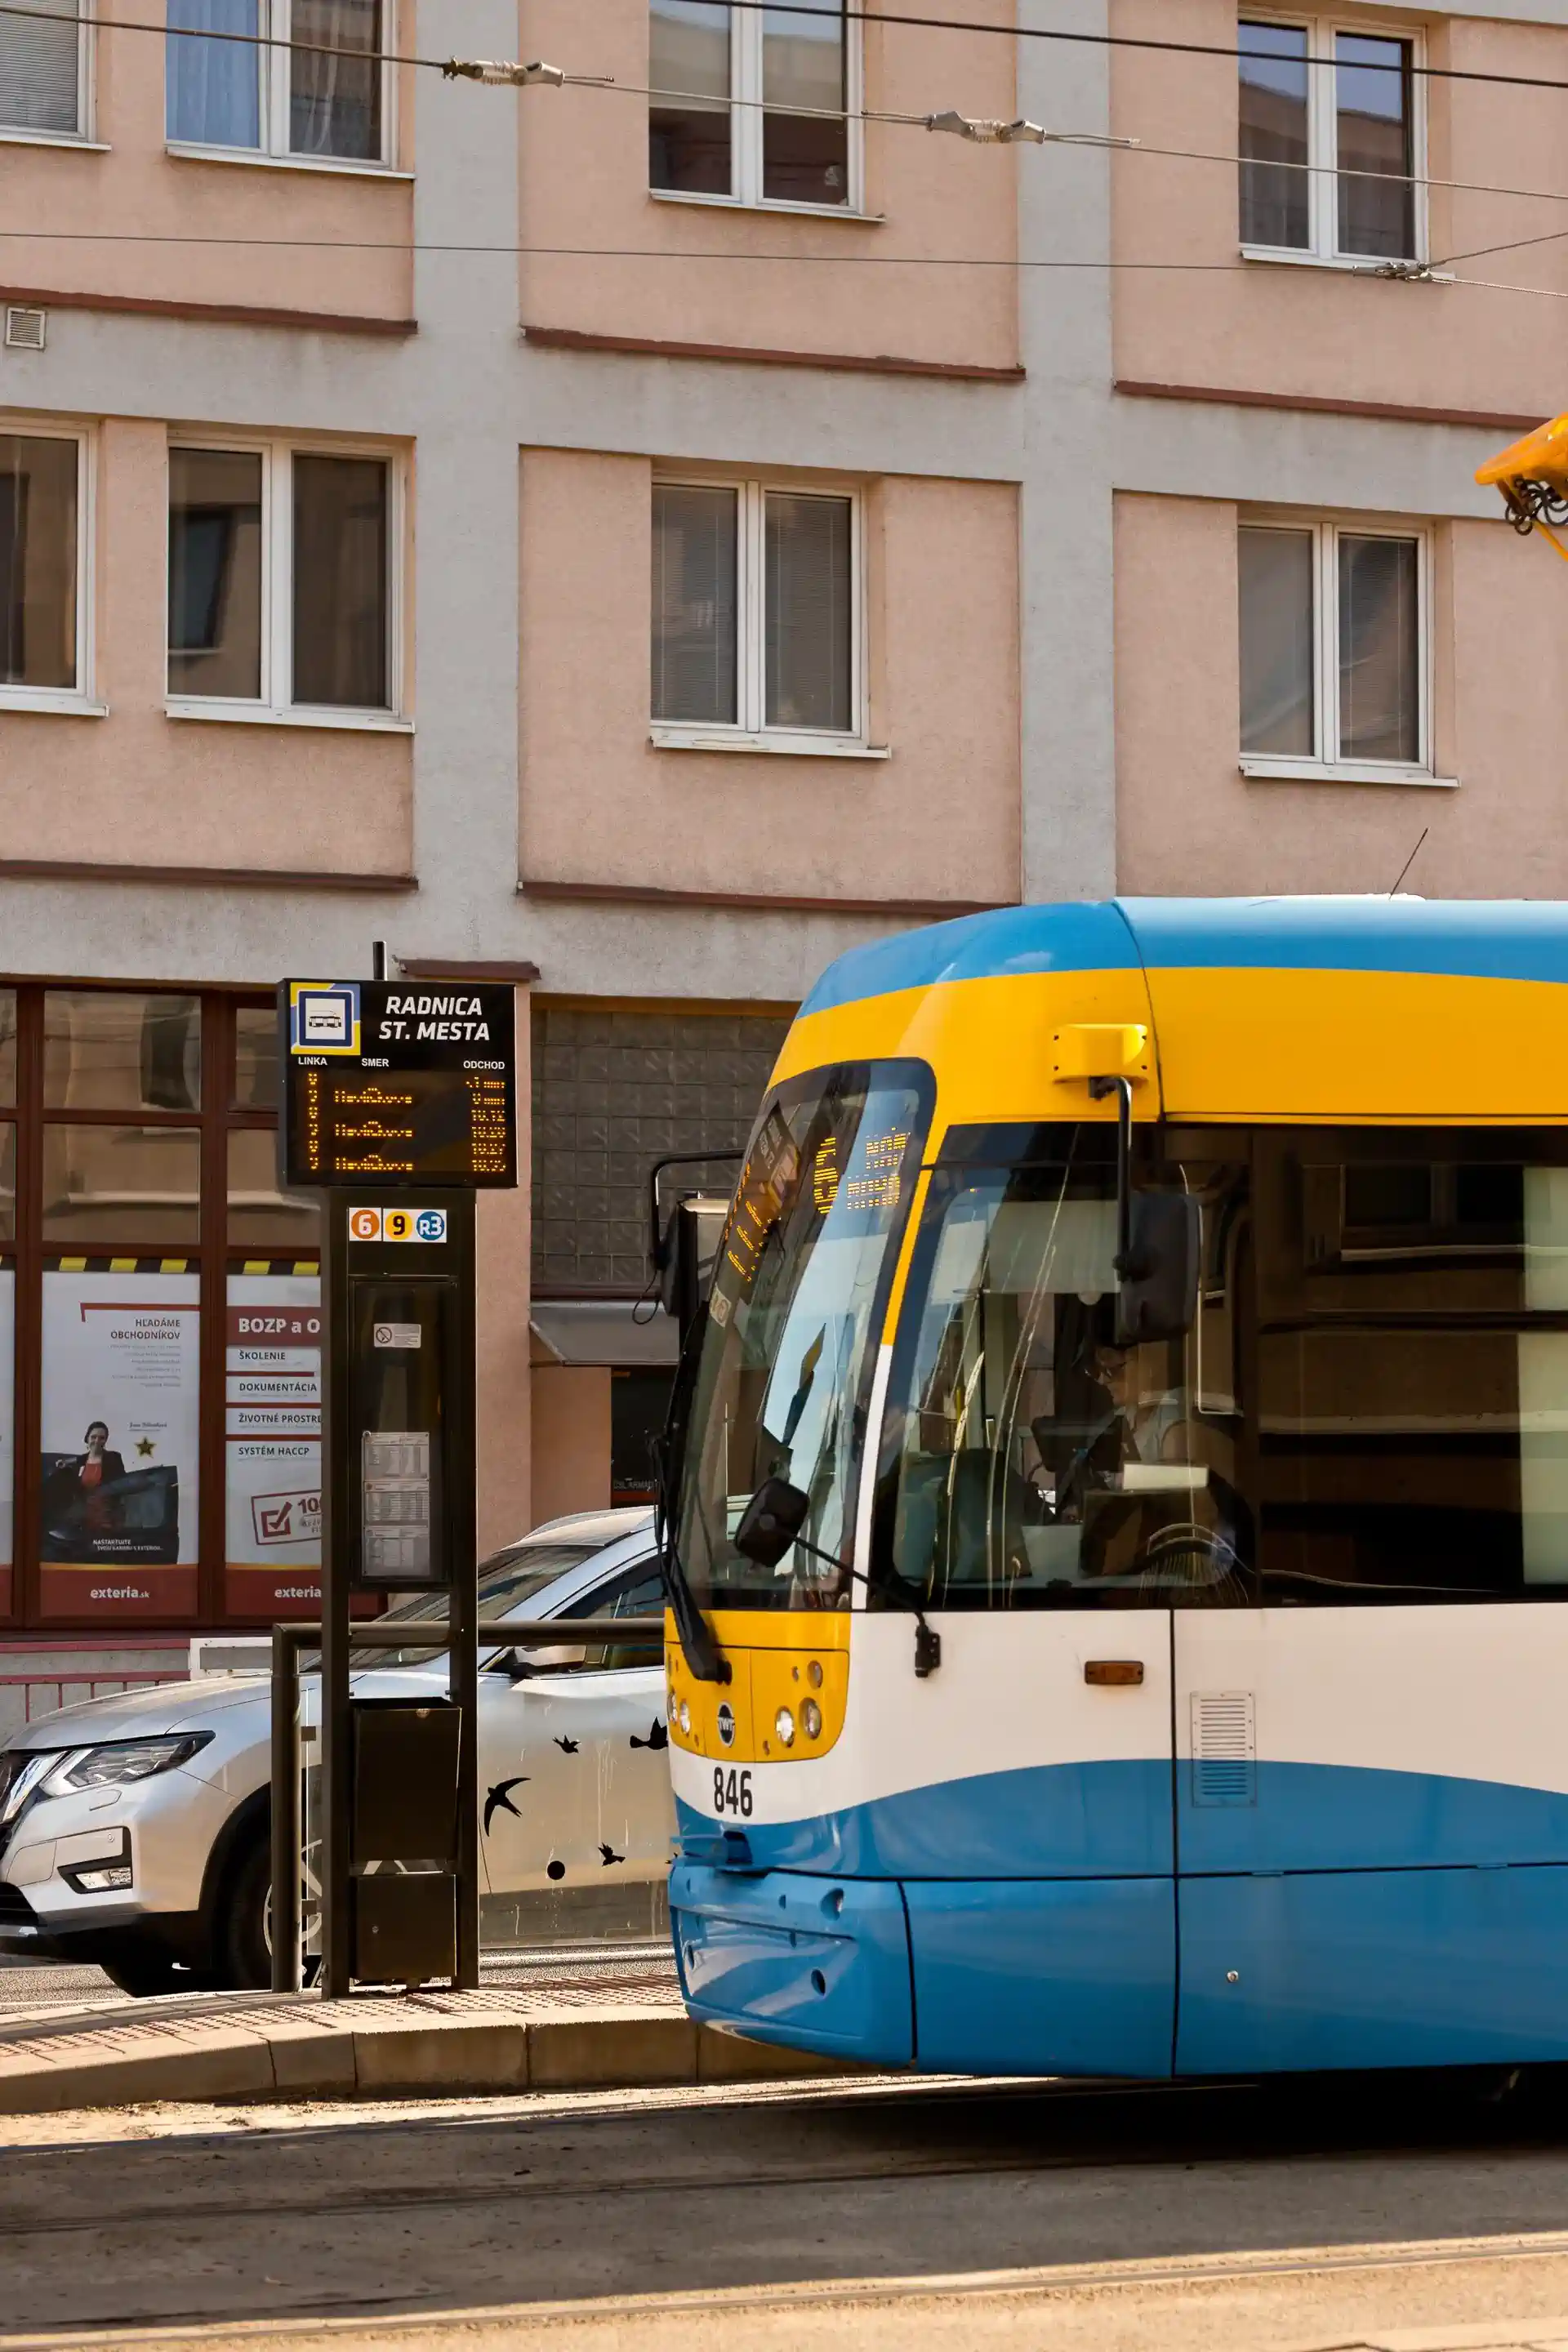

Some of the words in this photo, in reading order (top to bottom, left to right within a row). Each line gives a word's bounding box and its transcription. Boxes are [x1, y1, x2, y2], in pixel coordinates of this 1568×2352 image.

[385, 996, 483, 1016] RADNICA
[378, 1021, 411, 1040] ST.
[416, 1022, 490, 1041] MESTA
[297, 1057, 328, 1066] LINKA
[361, 1058, 390, 1067] SMER
[463, 1060, 506, 1070] ODCHOD
[359, 1214, 372, 1236] 6
[393, 1215, 406, 1236] 9
[419, 1215, 443, 1236] R3
[238, 1317, 287, 1334] BOZP
[291, 1321, 302, 1334] a
[110, 1330, 180, 1340] OBCHODNÍKOV
[238, 1349, 286, 1361] ŠKOLENIE
[239, 1381, 318, 1392] DOKUMENTÁCIA
[238, 1412, 278, 1423] ŽIVOTNÉ
[238, 1446, 275, 1455] SYSTÉM
[278, 1447, 310, 1456] HACCP
[90, 1586, 150, 1599] exteria.sk
[713, 1766, 753, 1817] 846
